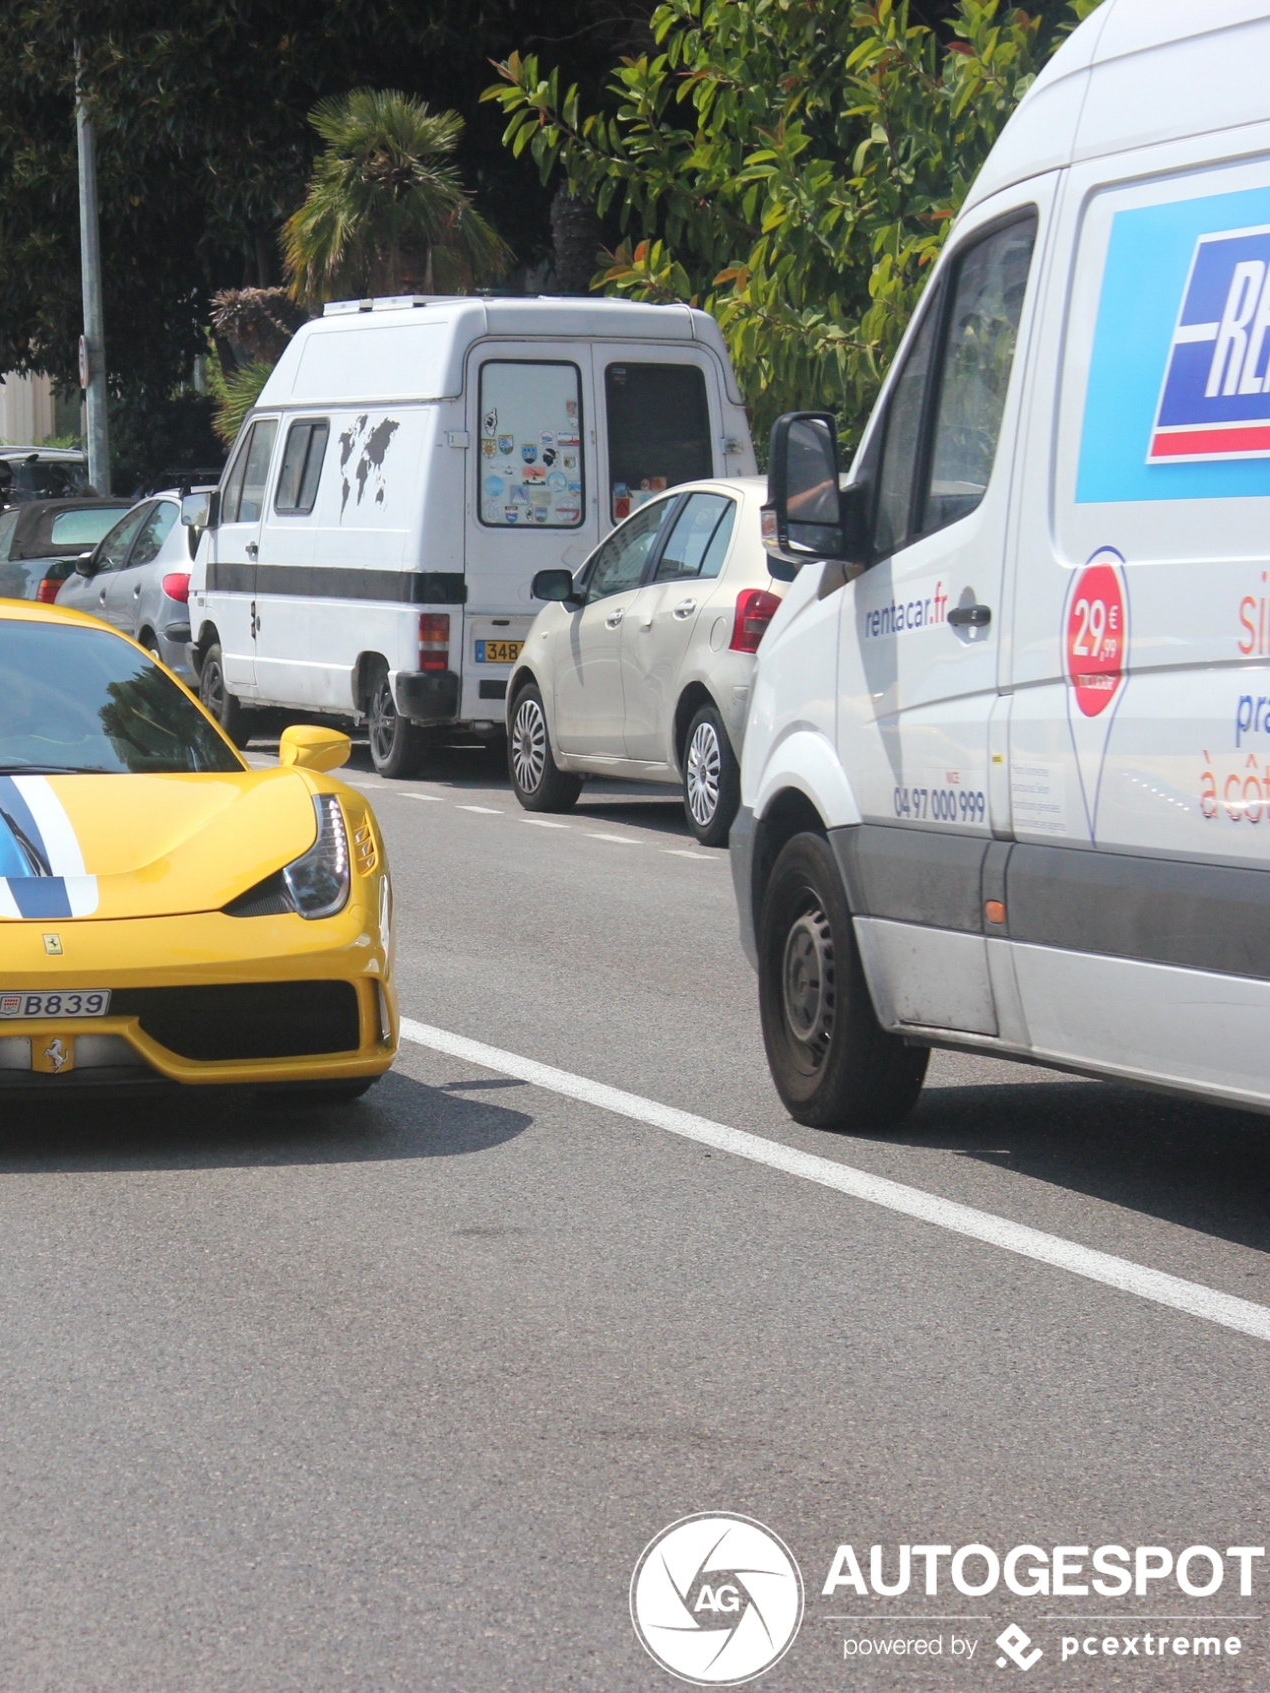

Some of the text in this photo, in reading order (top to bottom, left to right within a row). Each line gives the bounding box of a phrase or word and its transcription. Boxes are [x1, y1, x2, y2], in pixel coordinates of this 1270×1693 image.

[1204, 260, 1270, 397] RE
[865, 581, 948, 638] rentacar.fr
[1238, 571, 1270, 655] si
[894, 787, 910, 818] 04
[912, 788, 927, 819] 97
[931, 789, 957, 821] 000
[959, 790, 985, 823] 999
[1200, 750, 1217, 819] à
[24, 994, 104, 1016] B839
